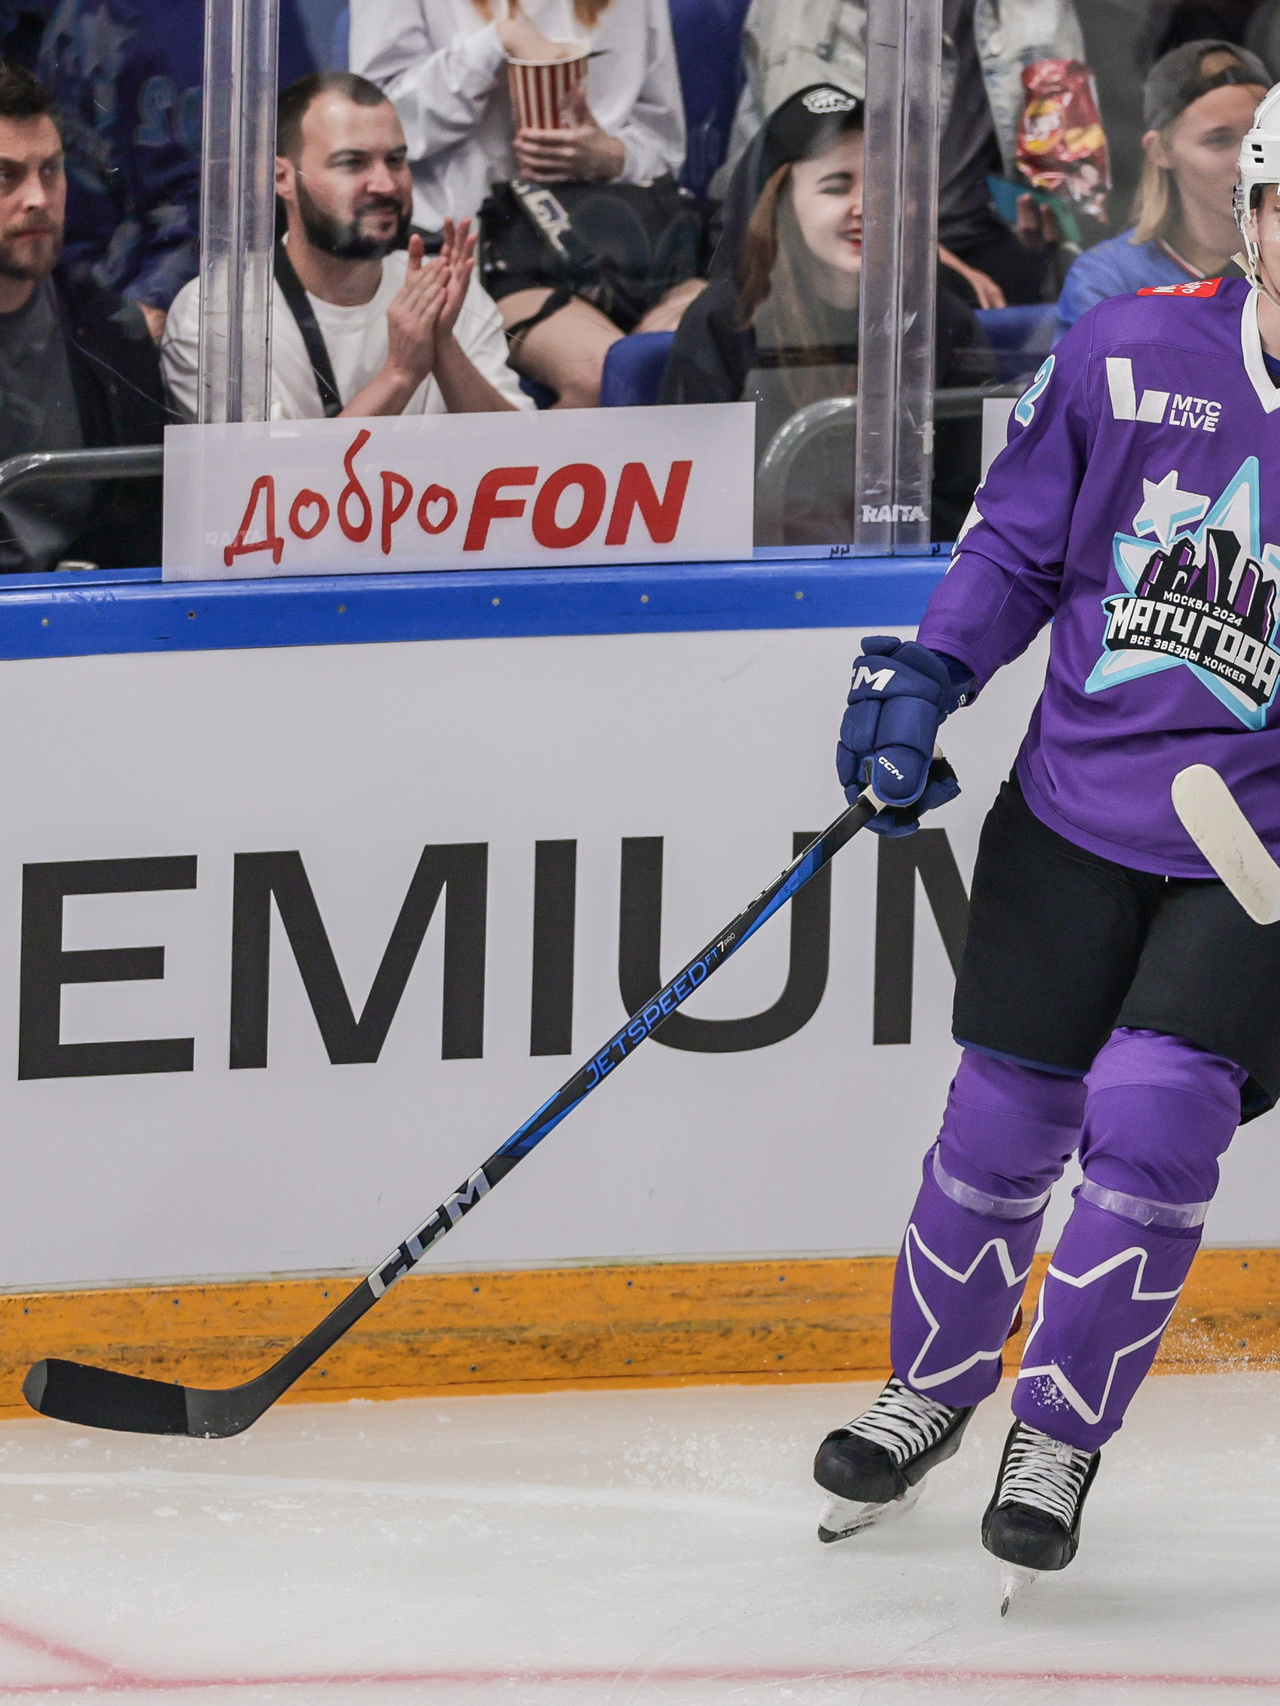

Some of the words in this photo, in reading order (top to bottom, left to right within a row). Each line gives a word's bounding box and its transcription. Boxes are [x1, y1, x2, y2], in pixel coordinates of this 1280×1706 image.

[1168, 412, 1220, 433] LIVE
[862, 504, 929, 522] RAITA
[1163, 590, 1210, 613] МОСКВА
[1212, 605, 1244, 627] 2024
[1129, 634, 1152, 647] ВСЕ
[1153, 637, 1200, 662] ЗВЁЗДЫ
[1202, 654, 1247, 685] ХОККЕЯ
[877, 755, 905, 781] CCM
[586, 961, 709, 1090] JETSPEED
[367, 1167, 491, 1299] CCM
